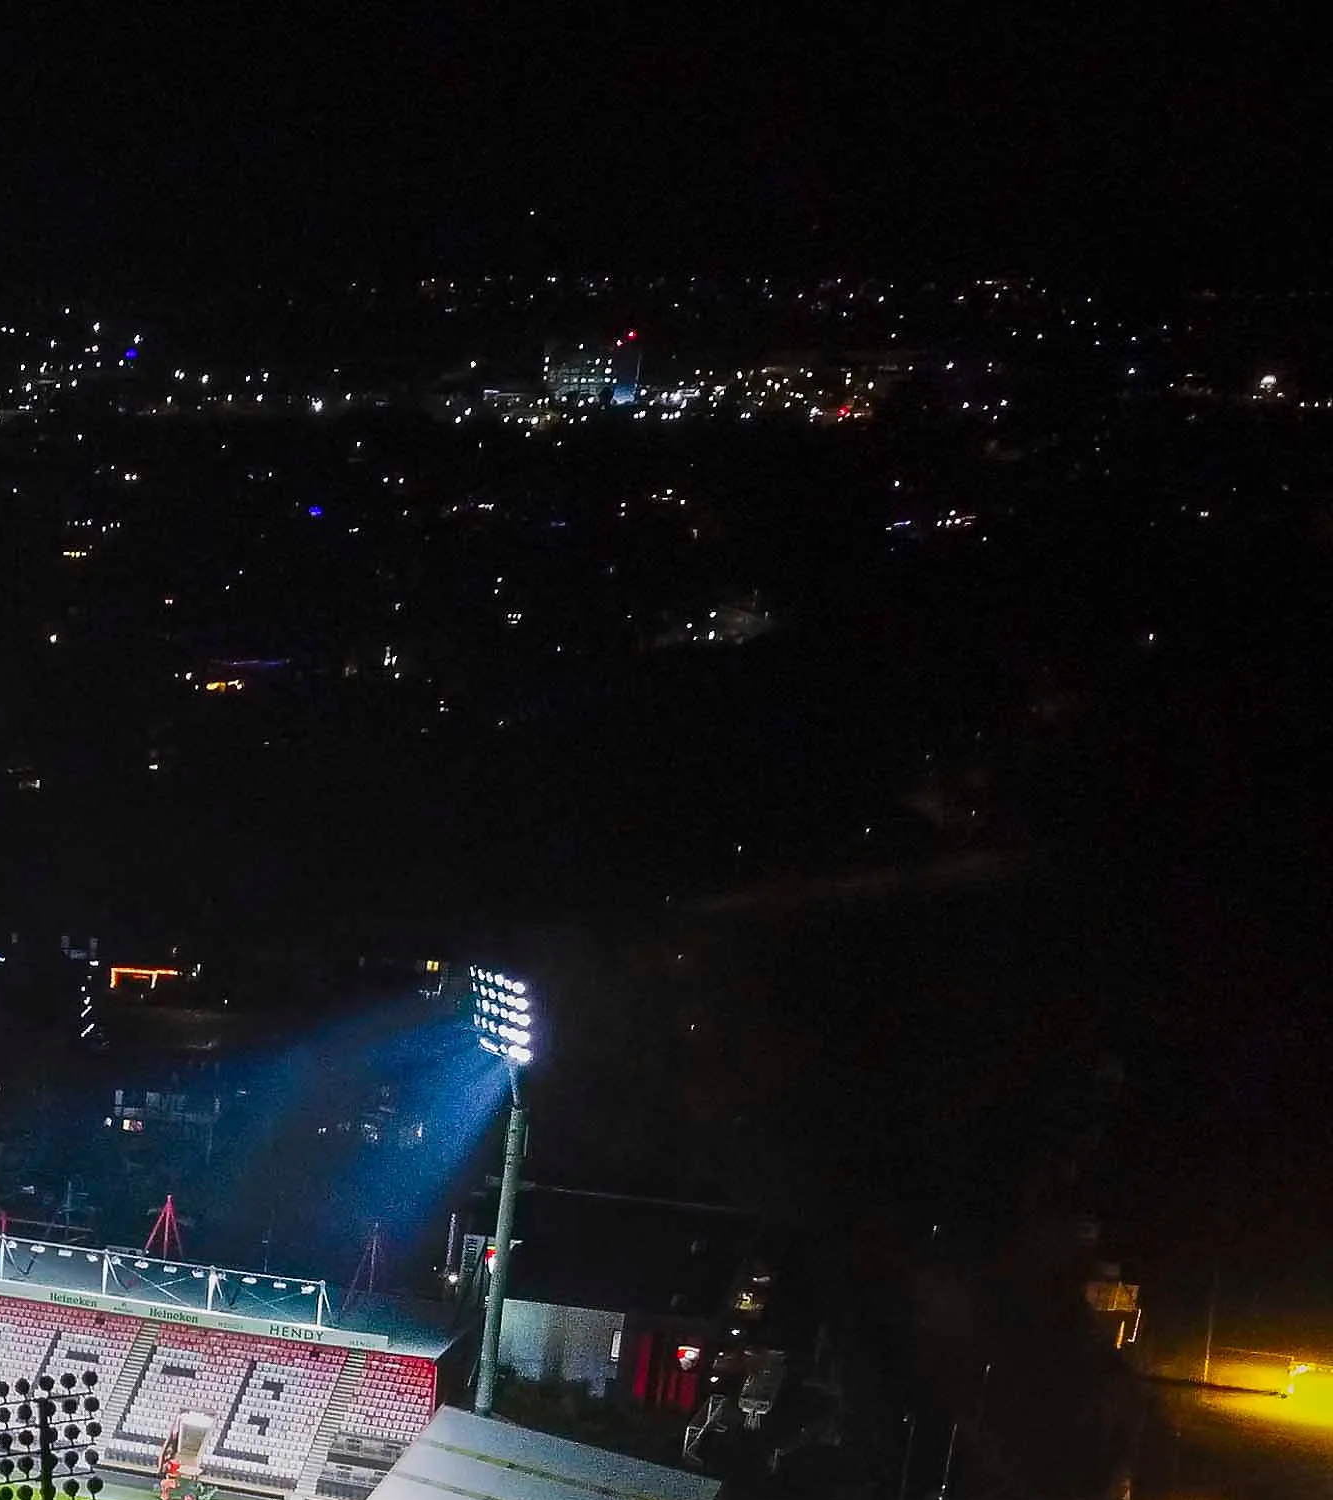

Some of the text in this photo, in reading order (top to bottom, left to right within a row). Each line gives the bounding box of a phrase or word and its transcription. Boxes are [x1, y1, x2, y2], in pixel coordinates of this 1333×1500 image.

[49, 1291, 98, 1308] Heineken
[149, 1306, 199, 1324] Heineken
[268, 1323, 325, 1342] HENDY
